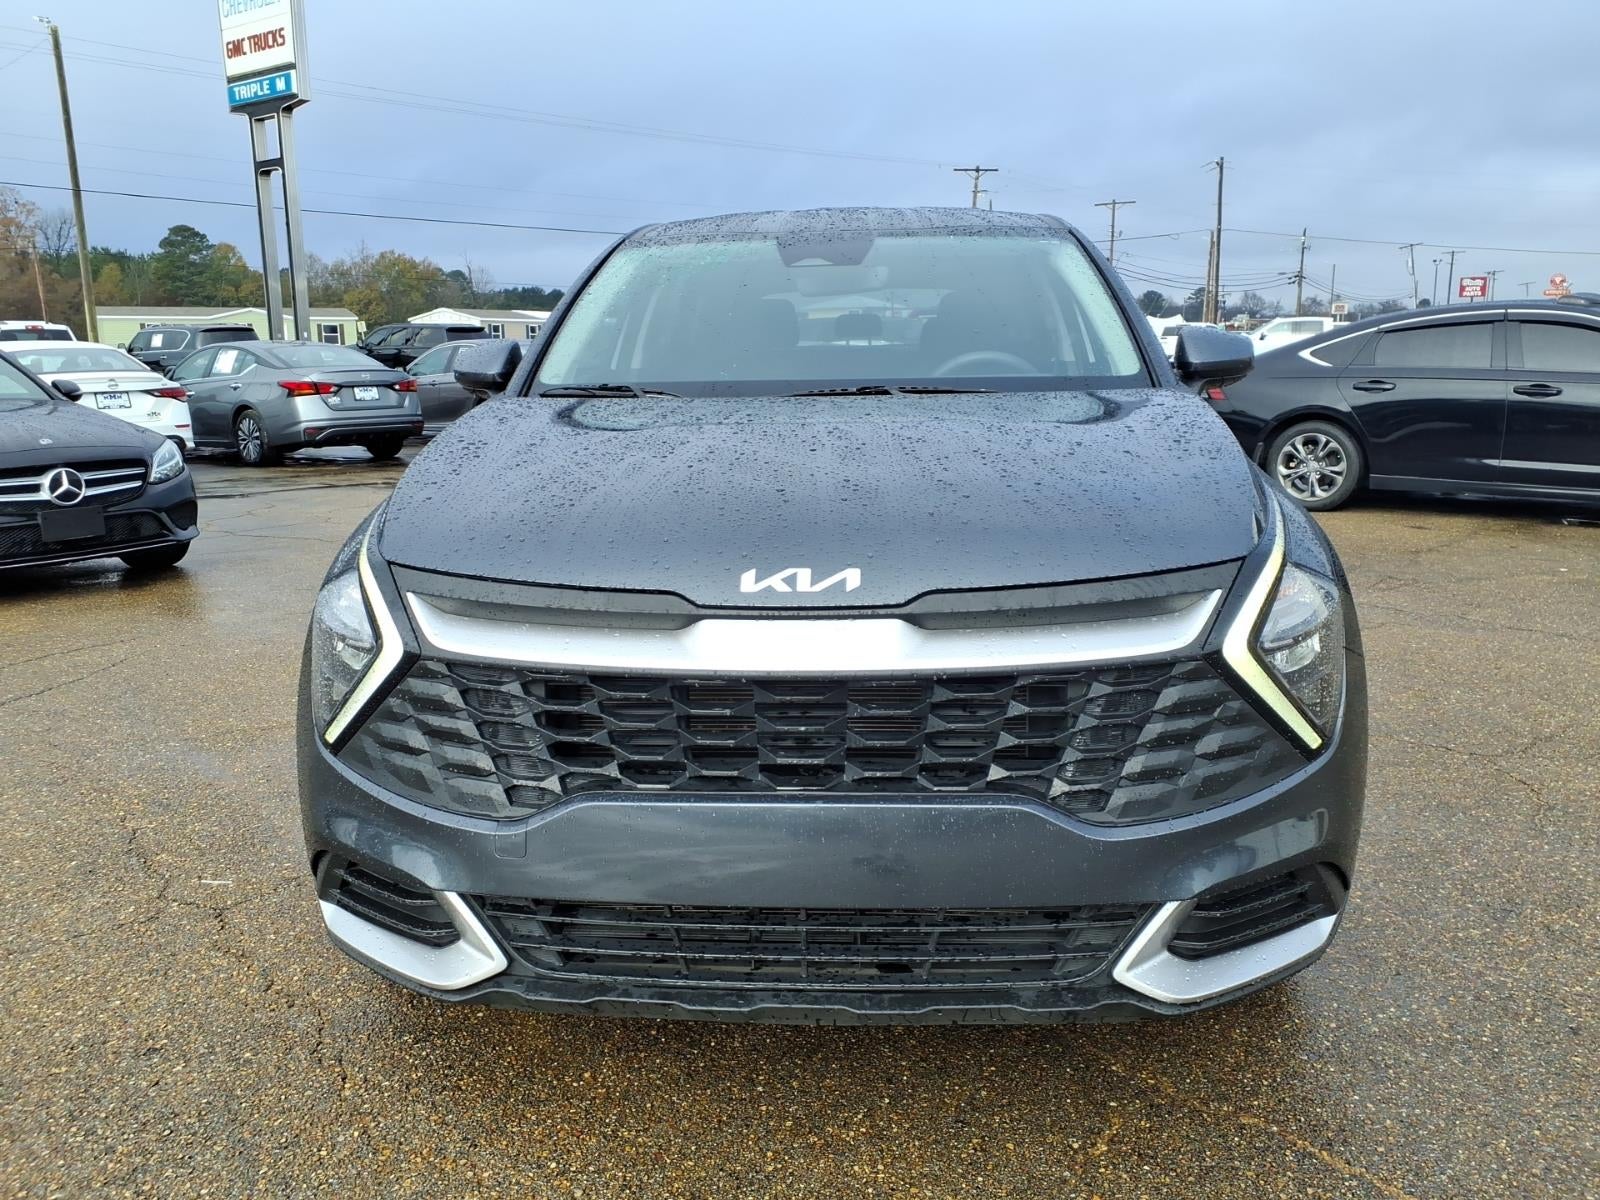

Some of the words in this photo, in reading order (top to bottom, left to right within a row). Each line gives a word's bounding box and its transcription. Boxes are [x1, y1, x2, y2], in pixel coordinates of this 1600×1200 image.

[225, 37, 248, 59] GMC
[247, 27, 286, 54] TRUCKS
[233, 80, 271, 100] TRIPLE
[276, 76, 286, 92] M
[740, 567, 861, 593] KIA
